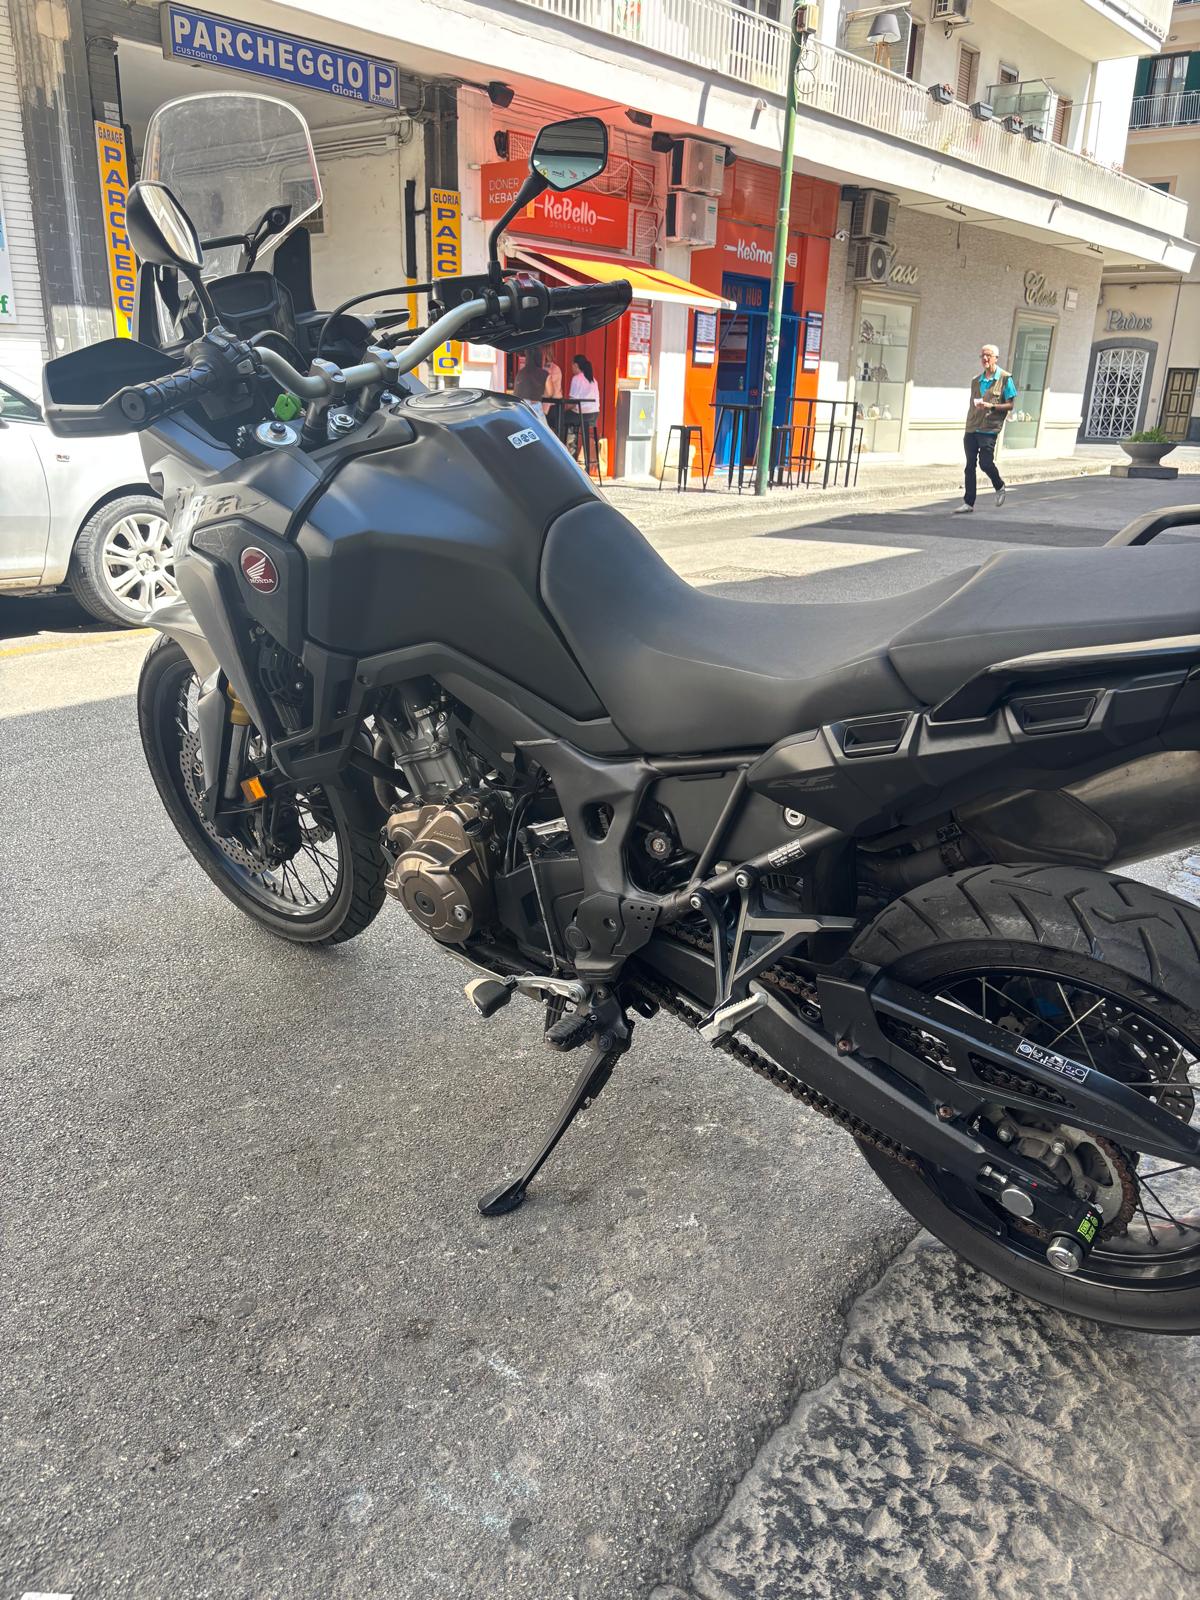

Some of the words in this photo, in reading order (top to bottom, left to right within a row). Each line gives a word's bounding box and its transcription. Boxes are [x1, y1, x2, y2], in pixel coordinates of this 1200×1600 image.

[174, 15, 363, 88] PARCHEGGIO
[176, 46, 218, 61] CUSTODITO
[332, 83, 363, 100] Gloria
[98, 127, 123, 144] GARAGE
[433, 193, 458, 205] GLORIA
[544, 194, 597, 225] KeBello
[104, 145, 134, 332] PARCHEGGI
[1105, 308, 1152, 332] Pados
